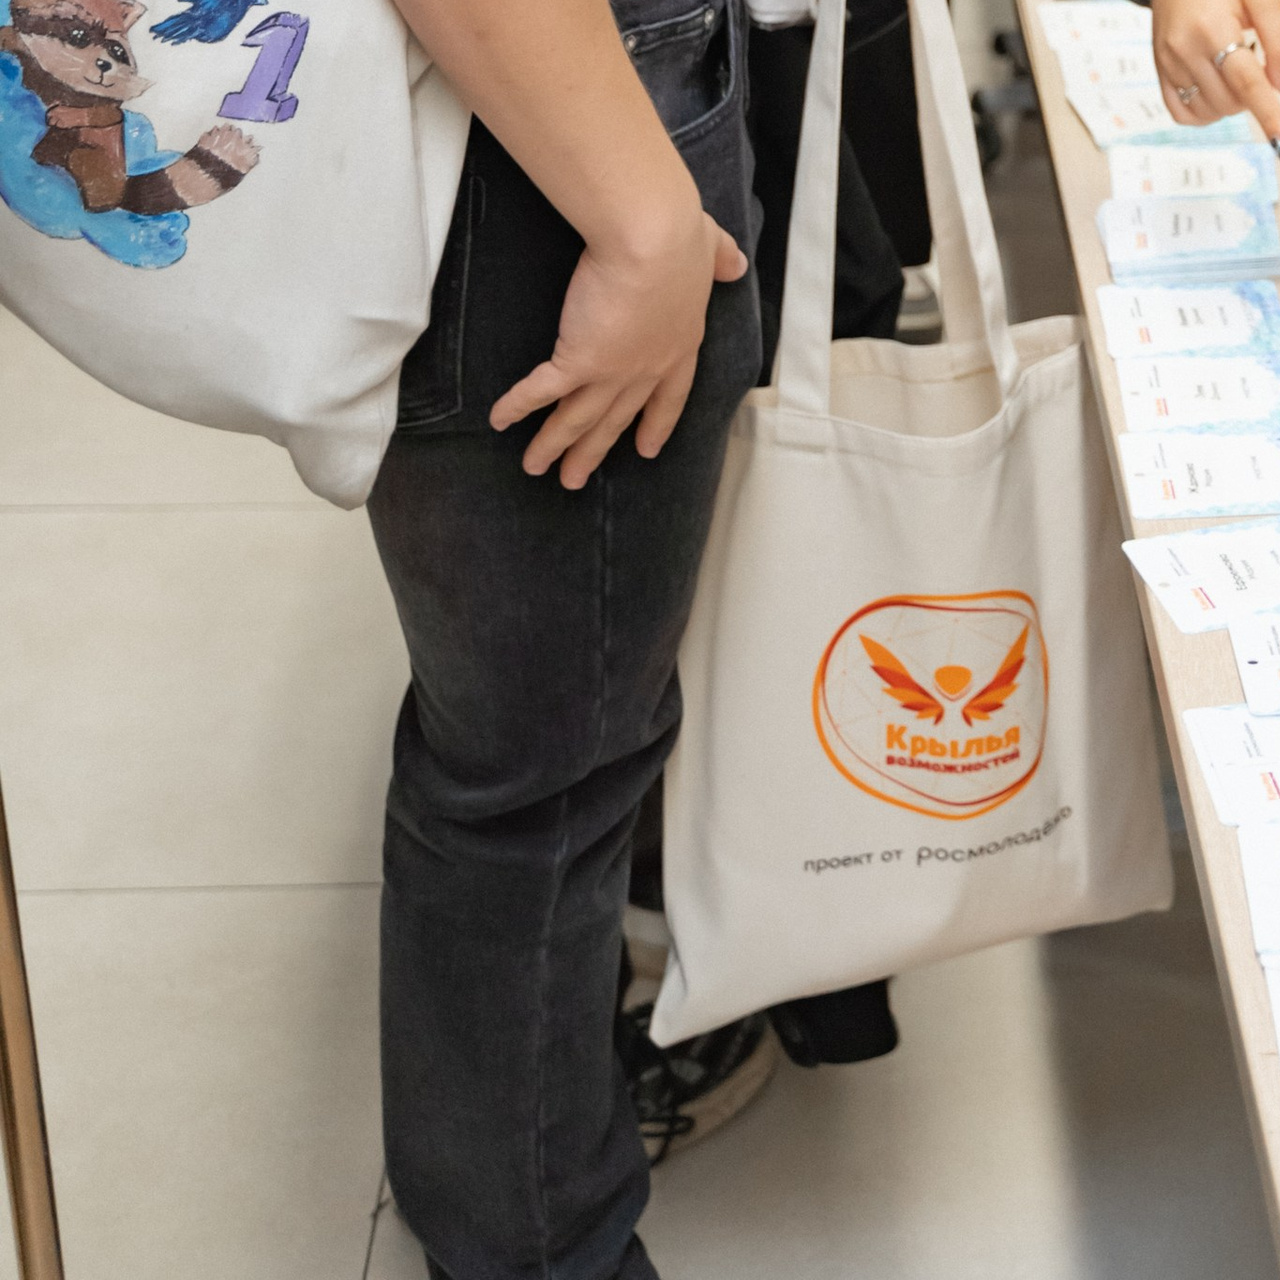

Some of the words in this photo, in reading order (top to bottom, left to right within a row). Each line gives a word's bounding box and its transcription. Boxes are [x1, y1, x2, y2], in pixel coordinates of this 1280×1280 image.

[217, 11, 310, 124] 1
[886, 723, 1021, 759] Крылья
[886, 749, 1020, 774] возможностей
[803, 851, 875, 874] проект
[880, 848, 903, 864] от
